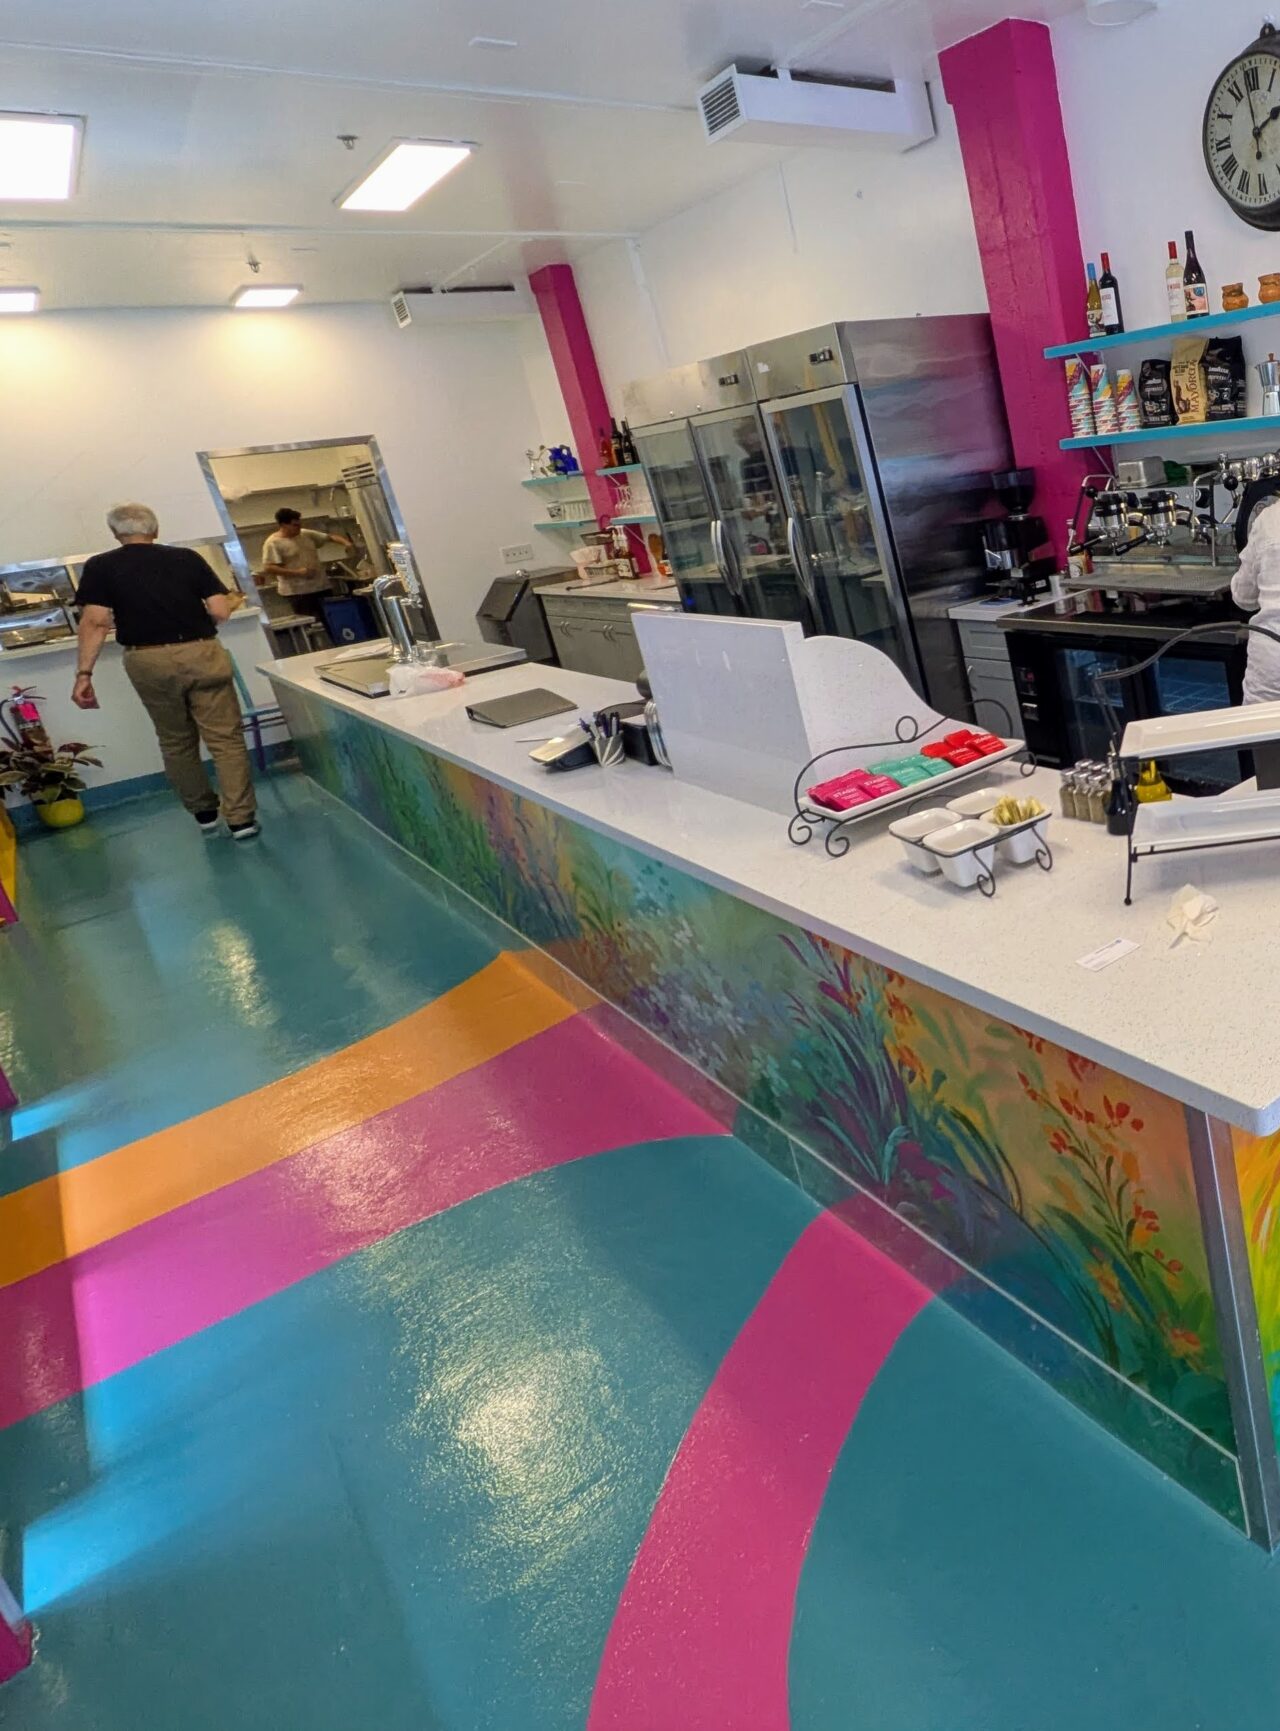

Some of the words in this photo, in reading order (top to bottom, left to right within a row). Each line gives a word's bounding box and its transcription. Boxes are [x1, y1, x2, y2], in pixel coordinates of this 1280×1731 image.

[1268, 68, 1276, 92] I
[1227, 80, 1244, 105] XI
[1217, 111, 1233, 125] X
